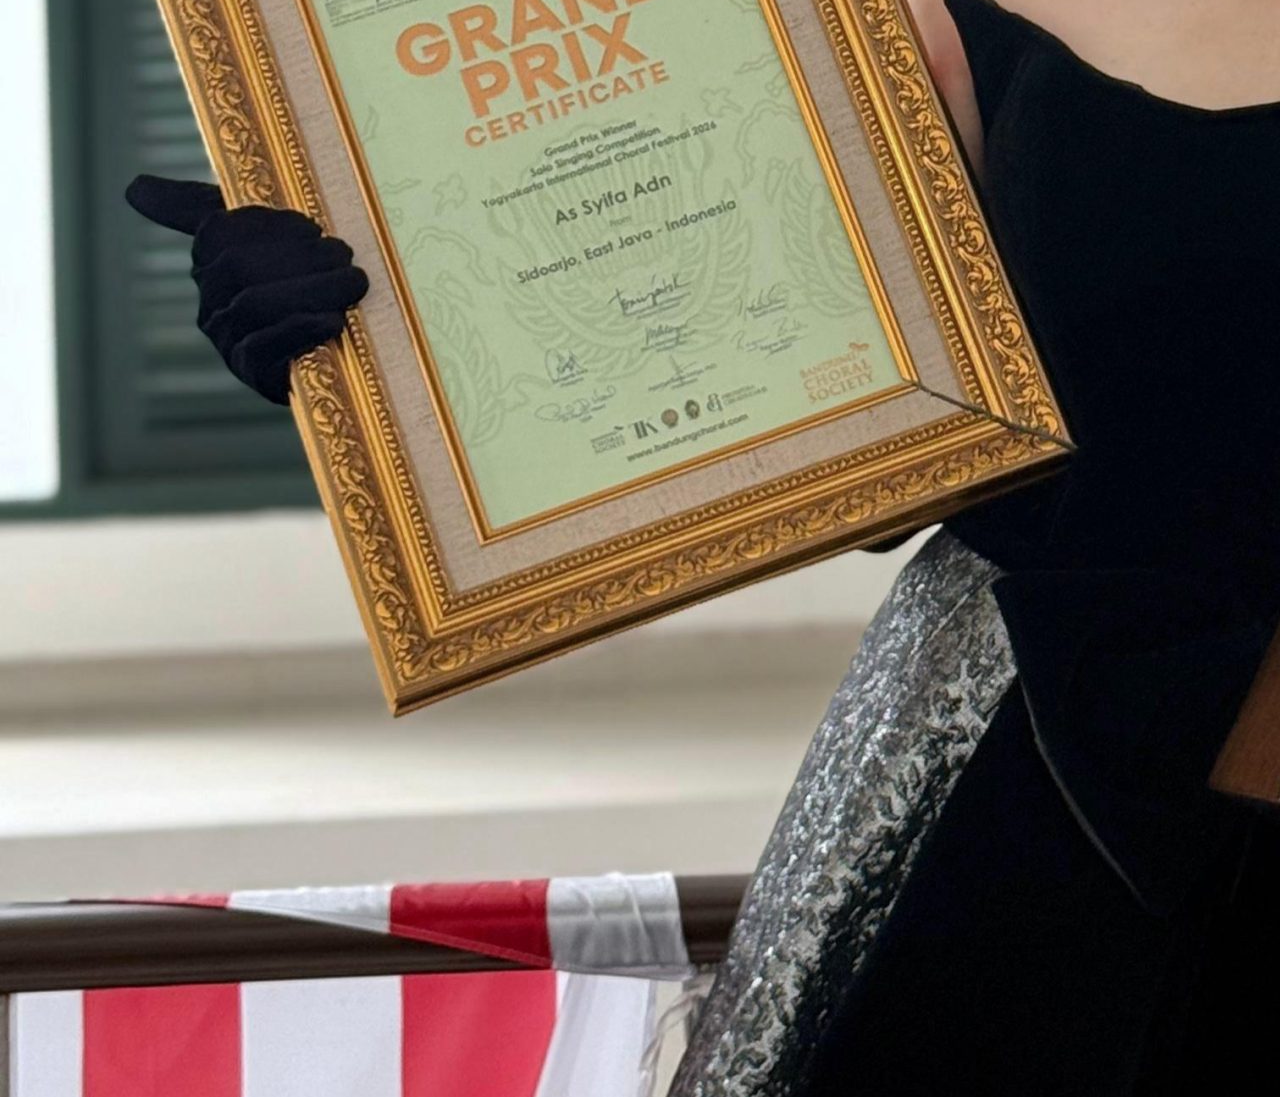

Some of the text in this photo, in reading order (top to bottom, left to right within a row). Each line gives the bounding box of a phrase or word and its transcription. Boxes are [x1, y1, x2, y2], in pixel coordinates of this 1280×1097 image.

[458, 10, 648, 118] PRIX
[464, 60, 669, 146] CERTIFICATE
[481, 120, 716, 208] Yogyakarta International Choral Festival 2026
[529, 126, 661, 177] Solo Singing Competition
[543, 119, 636, 157] Grand Prix Winner
[555, 175, 671, 225] As Syifa Adn
[583, 241, 613, 260] East
[618, 229, 653, 249] Java
[664, 199, 736, 232] Indonesia
[808, 370, 873, 403] SOCIETY
